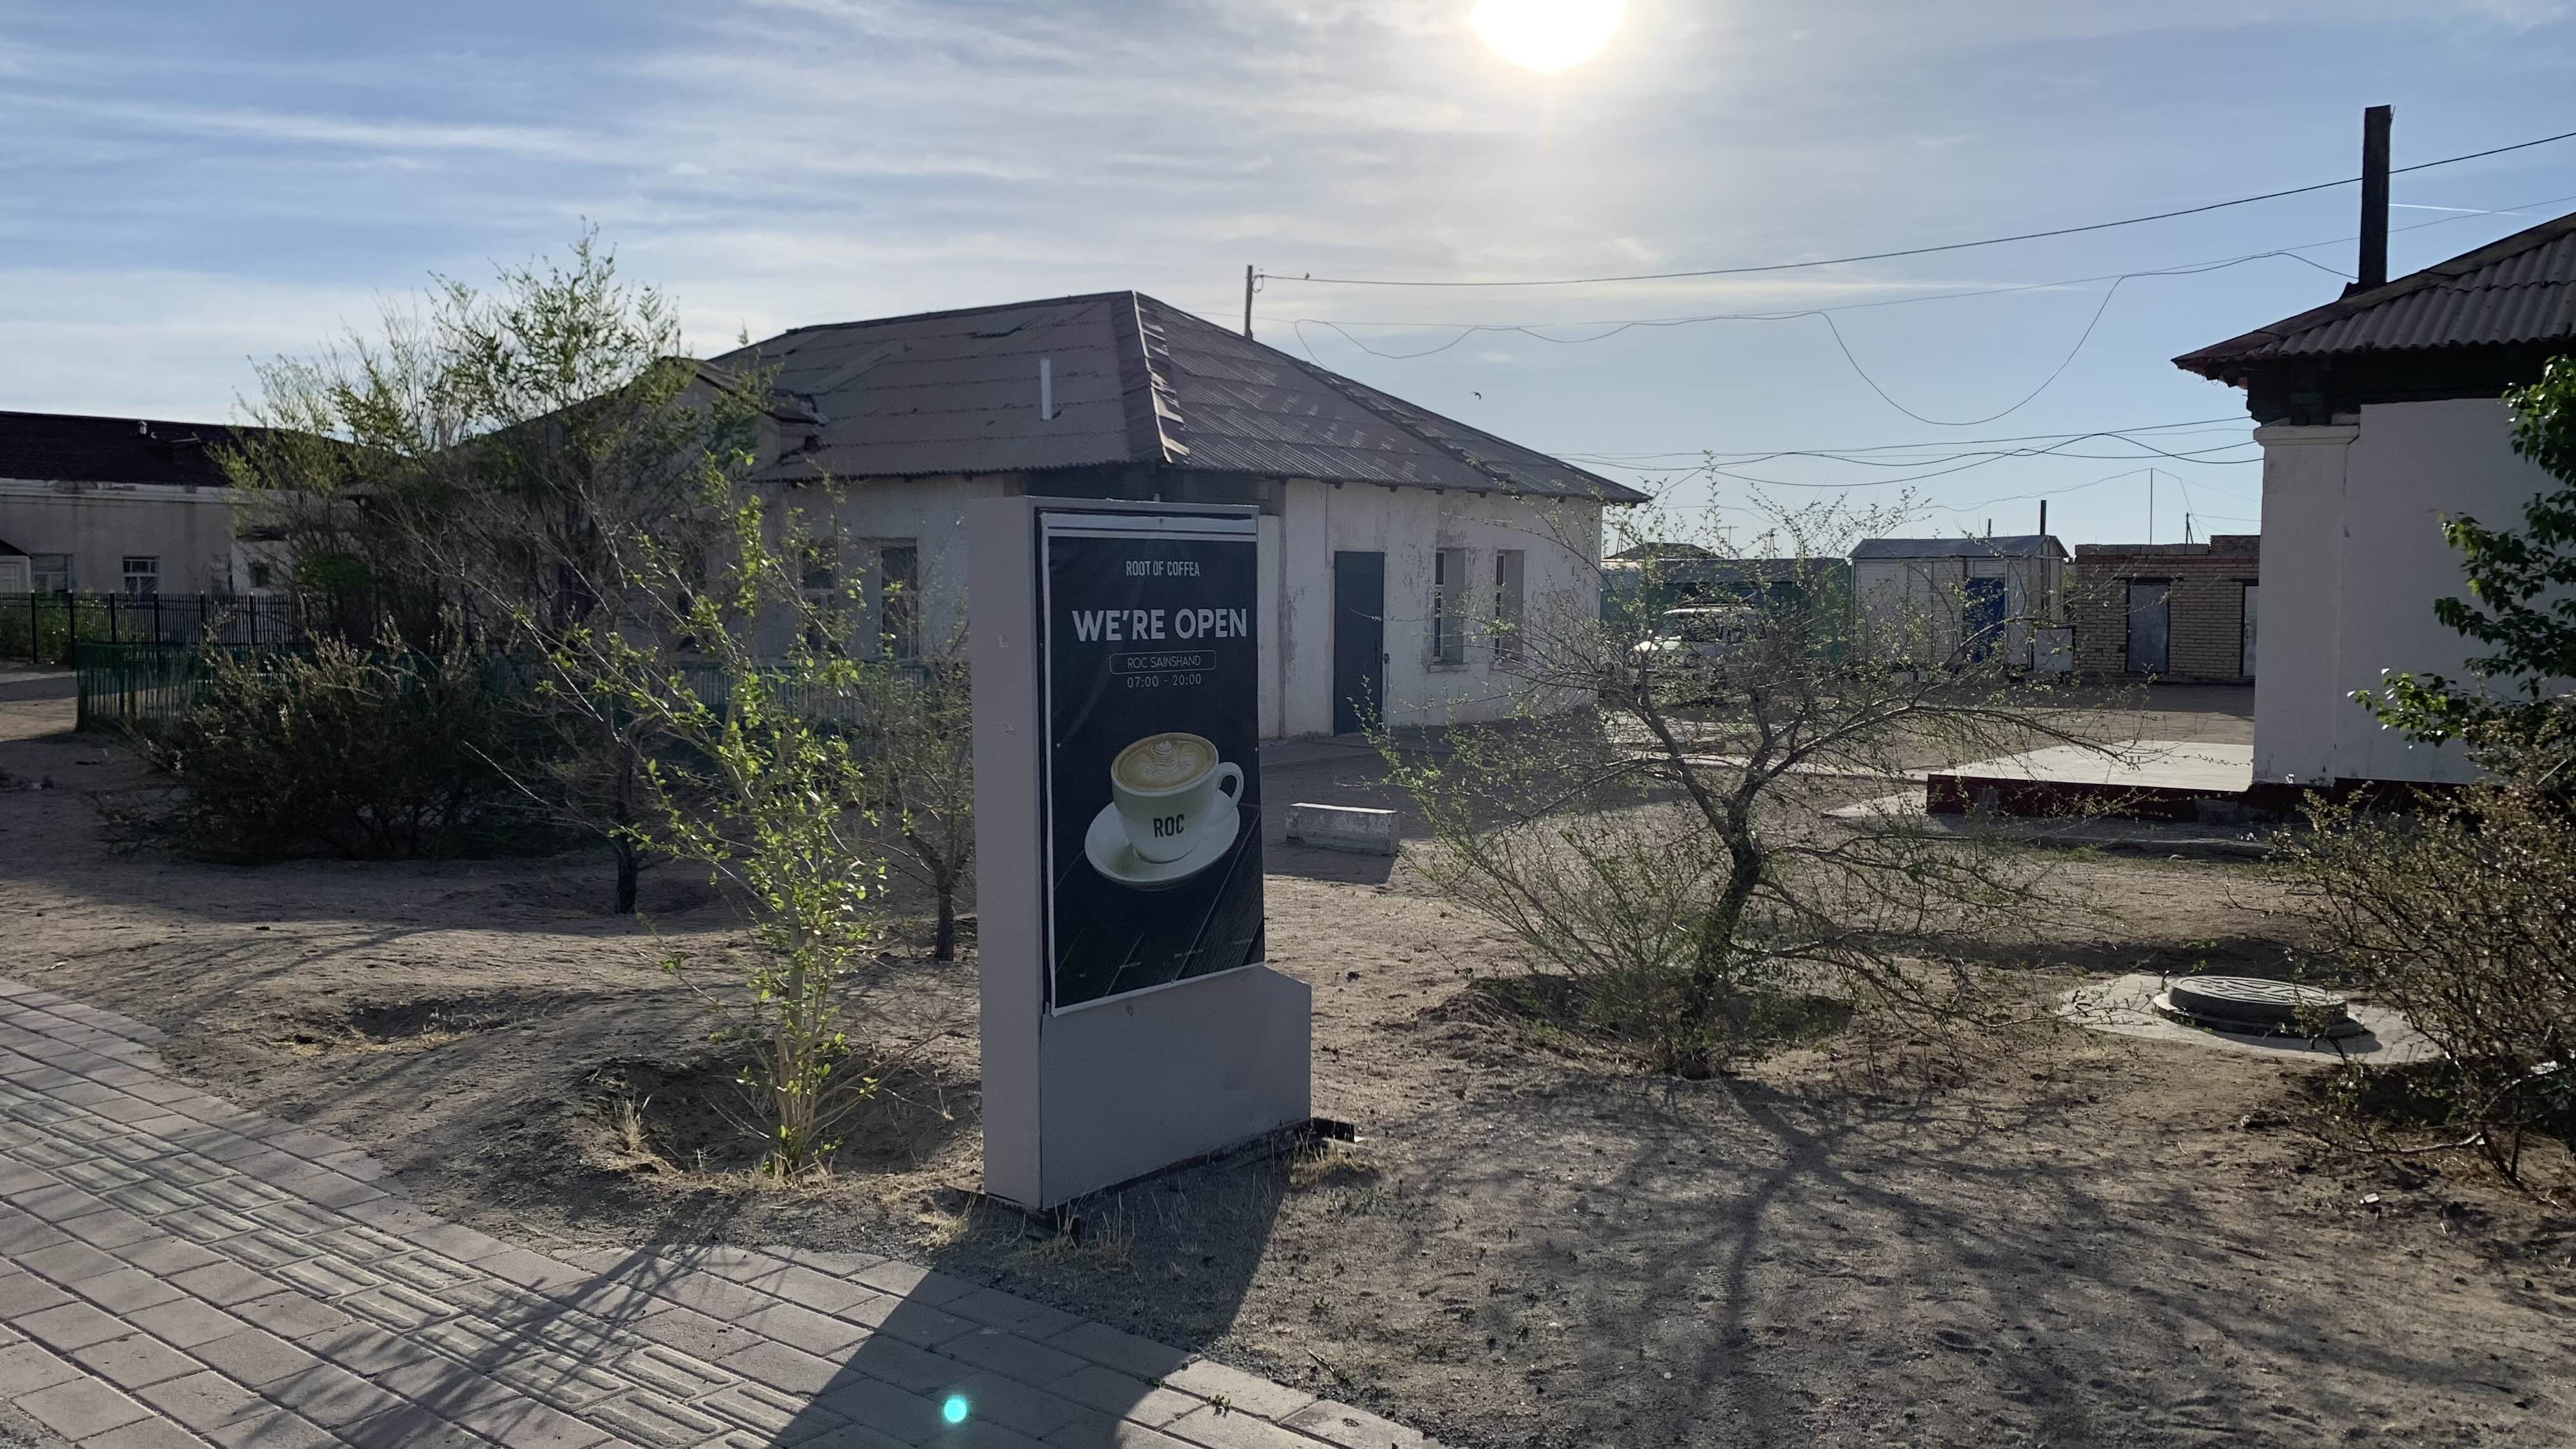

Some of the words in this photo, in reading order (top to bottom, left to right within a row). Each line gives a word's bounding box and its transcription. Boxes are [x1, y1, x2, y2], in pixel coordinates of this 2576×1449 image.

[1126, 560, 1151, 576] ROOT
[1153, 561, 1164, 576] OF
[1167, 562, 1200, 576] COFFEA
[1175, 608, 1247, 639] OPEN
[1127, 657, 1147, 669] ROC
[1150, 656, 1201, 668] SAINSHAND
[1127, 675, 1158, 688] 07:00
[1172, 674, 1202, 686] 20:00
[1153, 814, 1184, 838] ROC
